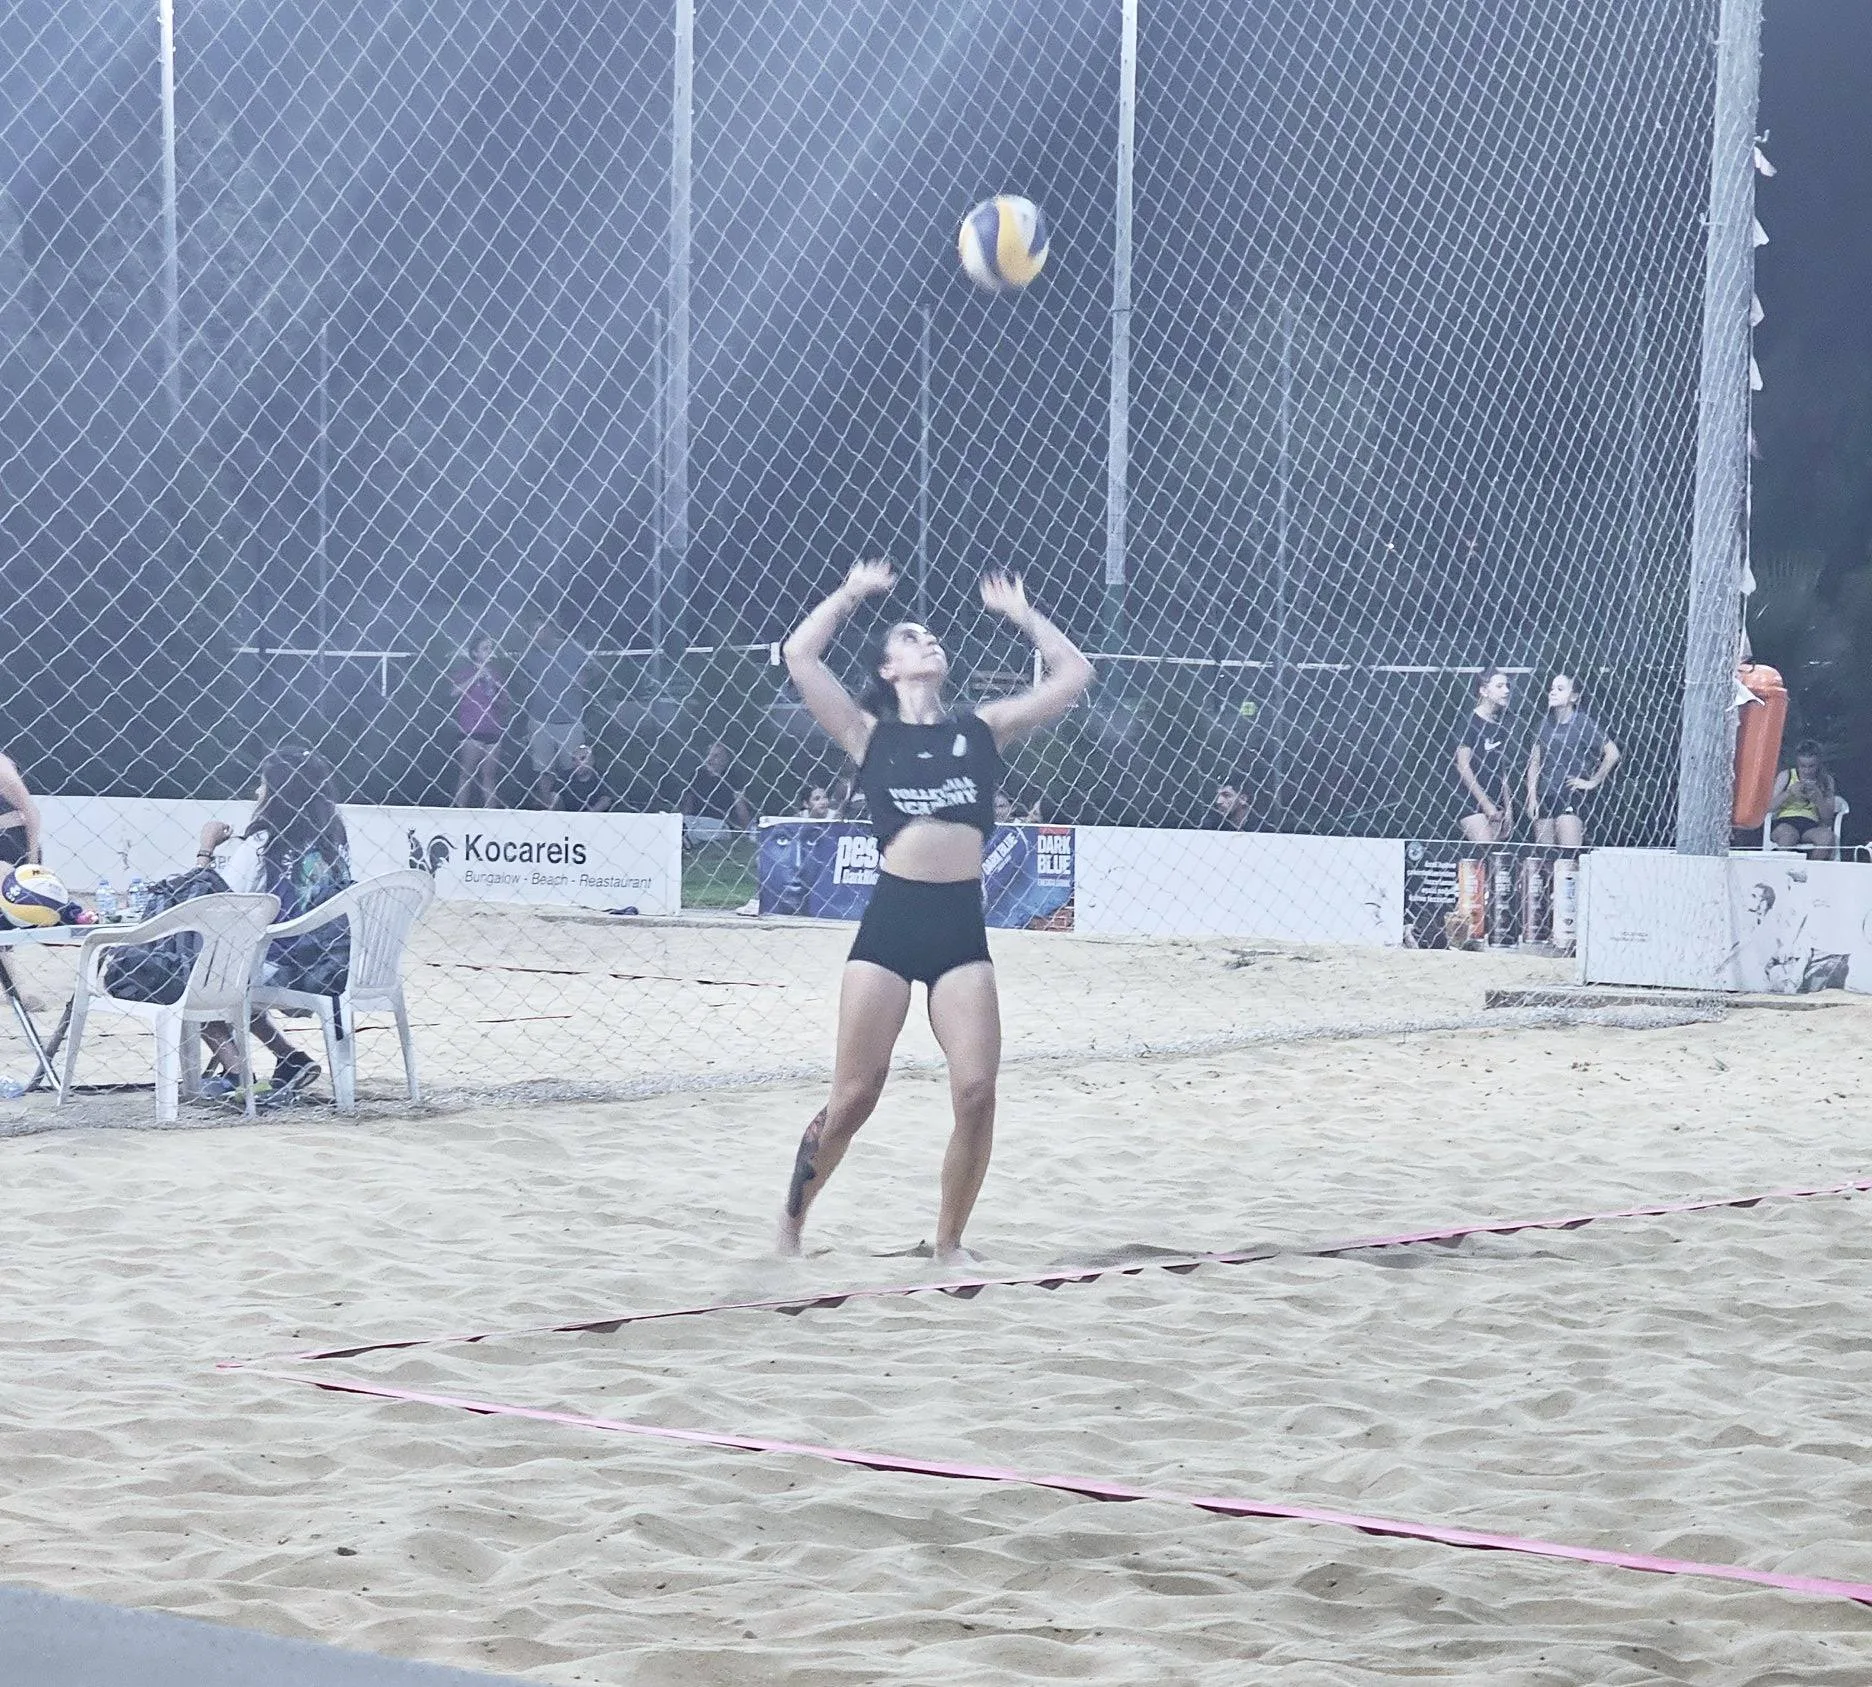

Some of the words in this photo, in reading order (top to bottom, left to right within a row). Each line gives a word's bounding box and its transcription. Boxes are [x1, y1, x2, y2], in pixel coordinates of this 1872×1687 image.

[464, 833, 588, 865] Kocareis
[1037, 835, 1072, 854] DARK
[1037, 854, 1072, 874] BLUE
[464, 870, 521, 887] Bungalow
[531, 872, 569, 886] Beach
[579, 873, 652, 889] Reastaurant
